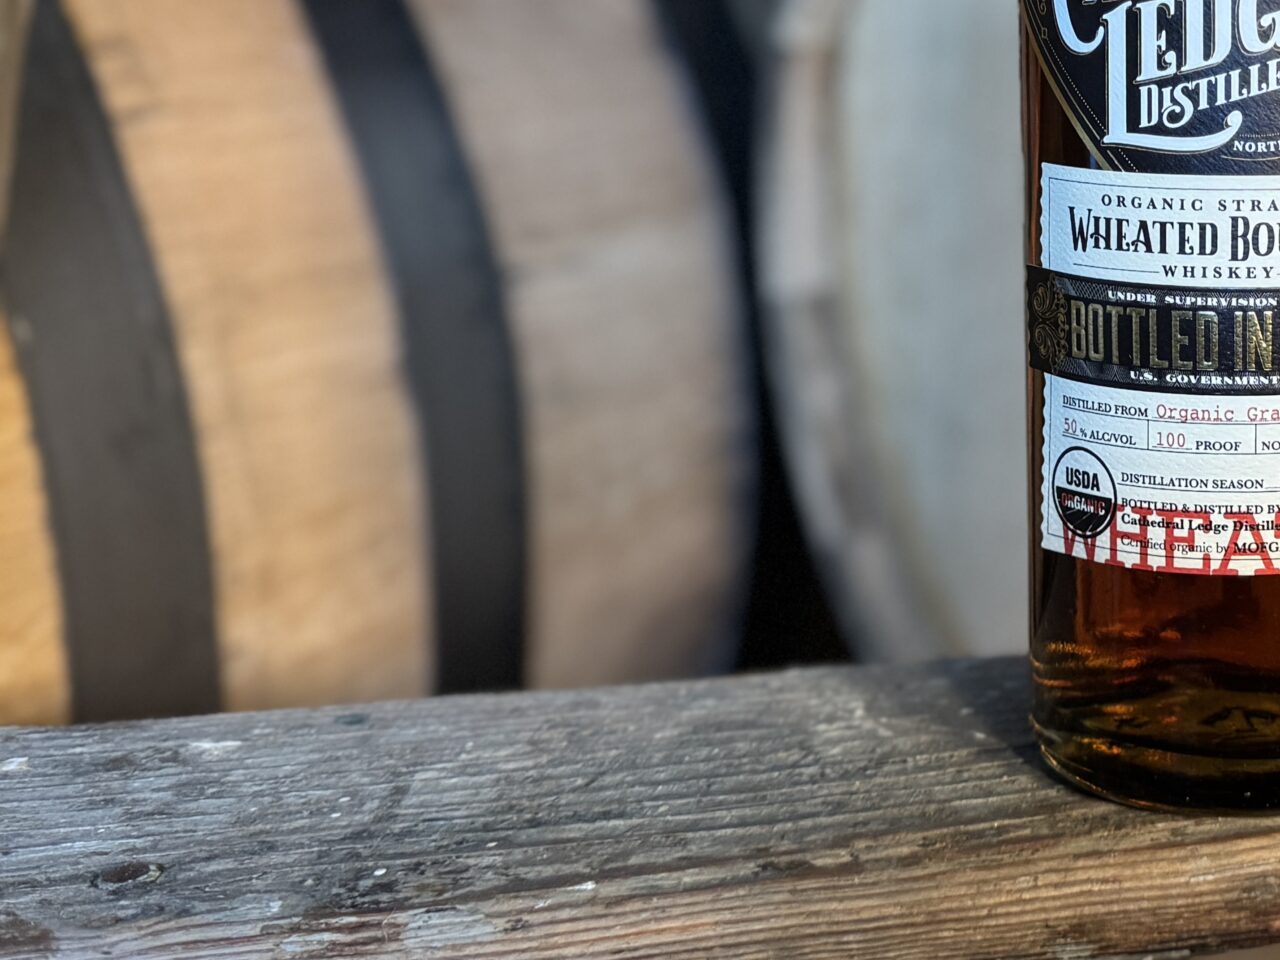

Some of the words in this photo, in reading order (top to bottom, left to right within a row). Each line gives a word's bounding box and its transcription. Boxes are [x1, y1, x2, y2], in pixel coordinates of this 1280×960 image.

[1101, 193, 1203, 211] ORGANIC
[1068, 206, 1218, 256] WHEATED
[1161, 265, 1274, 279] WHISKEY
[1108, 290, 1156, 303] UNDER
[1165, 295, 1278, 306] SUPERVISION
[1070, 299, 1218, 371] BOTTLED
[1234, 310, 1273, 371] IN
[1130, 370, 1158, 382] U.S.
[1166, 373, 1280, 385] GOVERNMENT
[1062, 394, 1111, 414] DISTILLED
[1114, 403, 1149, 418] FROM
[1156, 403, 1234, 424] Organic
[1064, 417, 1077, 434] 50
[1089, 430, 1136, 446] ALC/VOL
[1156, 431, 1186, 448] 100
[1195, 440, 1242, 452] PROOF
[1065, 466, 1101, 492] USDA
[1121, 471, 1208, 489] DISTILLATION
[1212, 478, 1264, 490] SEASON
[1060, 491, 1106, 517] ORGANIC
[1121, 497, 1178, 513] BOTTLED
[1181, 502, 1191, 513] &
[1194, 503, 1263, 515] DISTILLED
[1121, 512, 1184, 530] Cathedral
[1188, 519, 1228, 534] Ledge
[1120, 535, 1166, 551] Certified
[1169, 541, 1213, 555] organic
[1216, 542, 1228, 557] by
